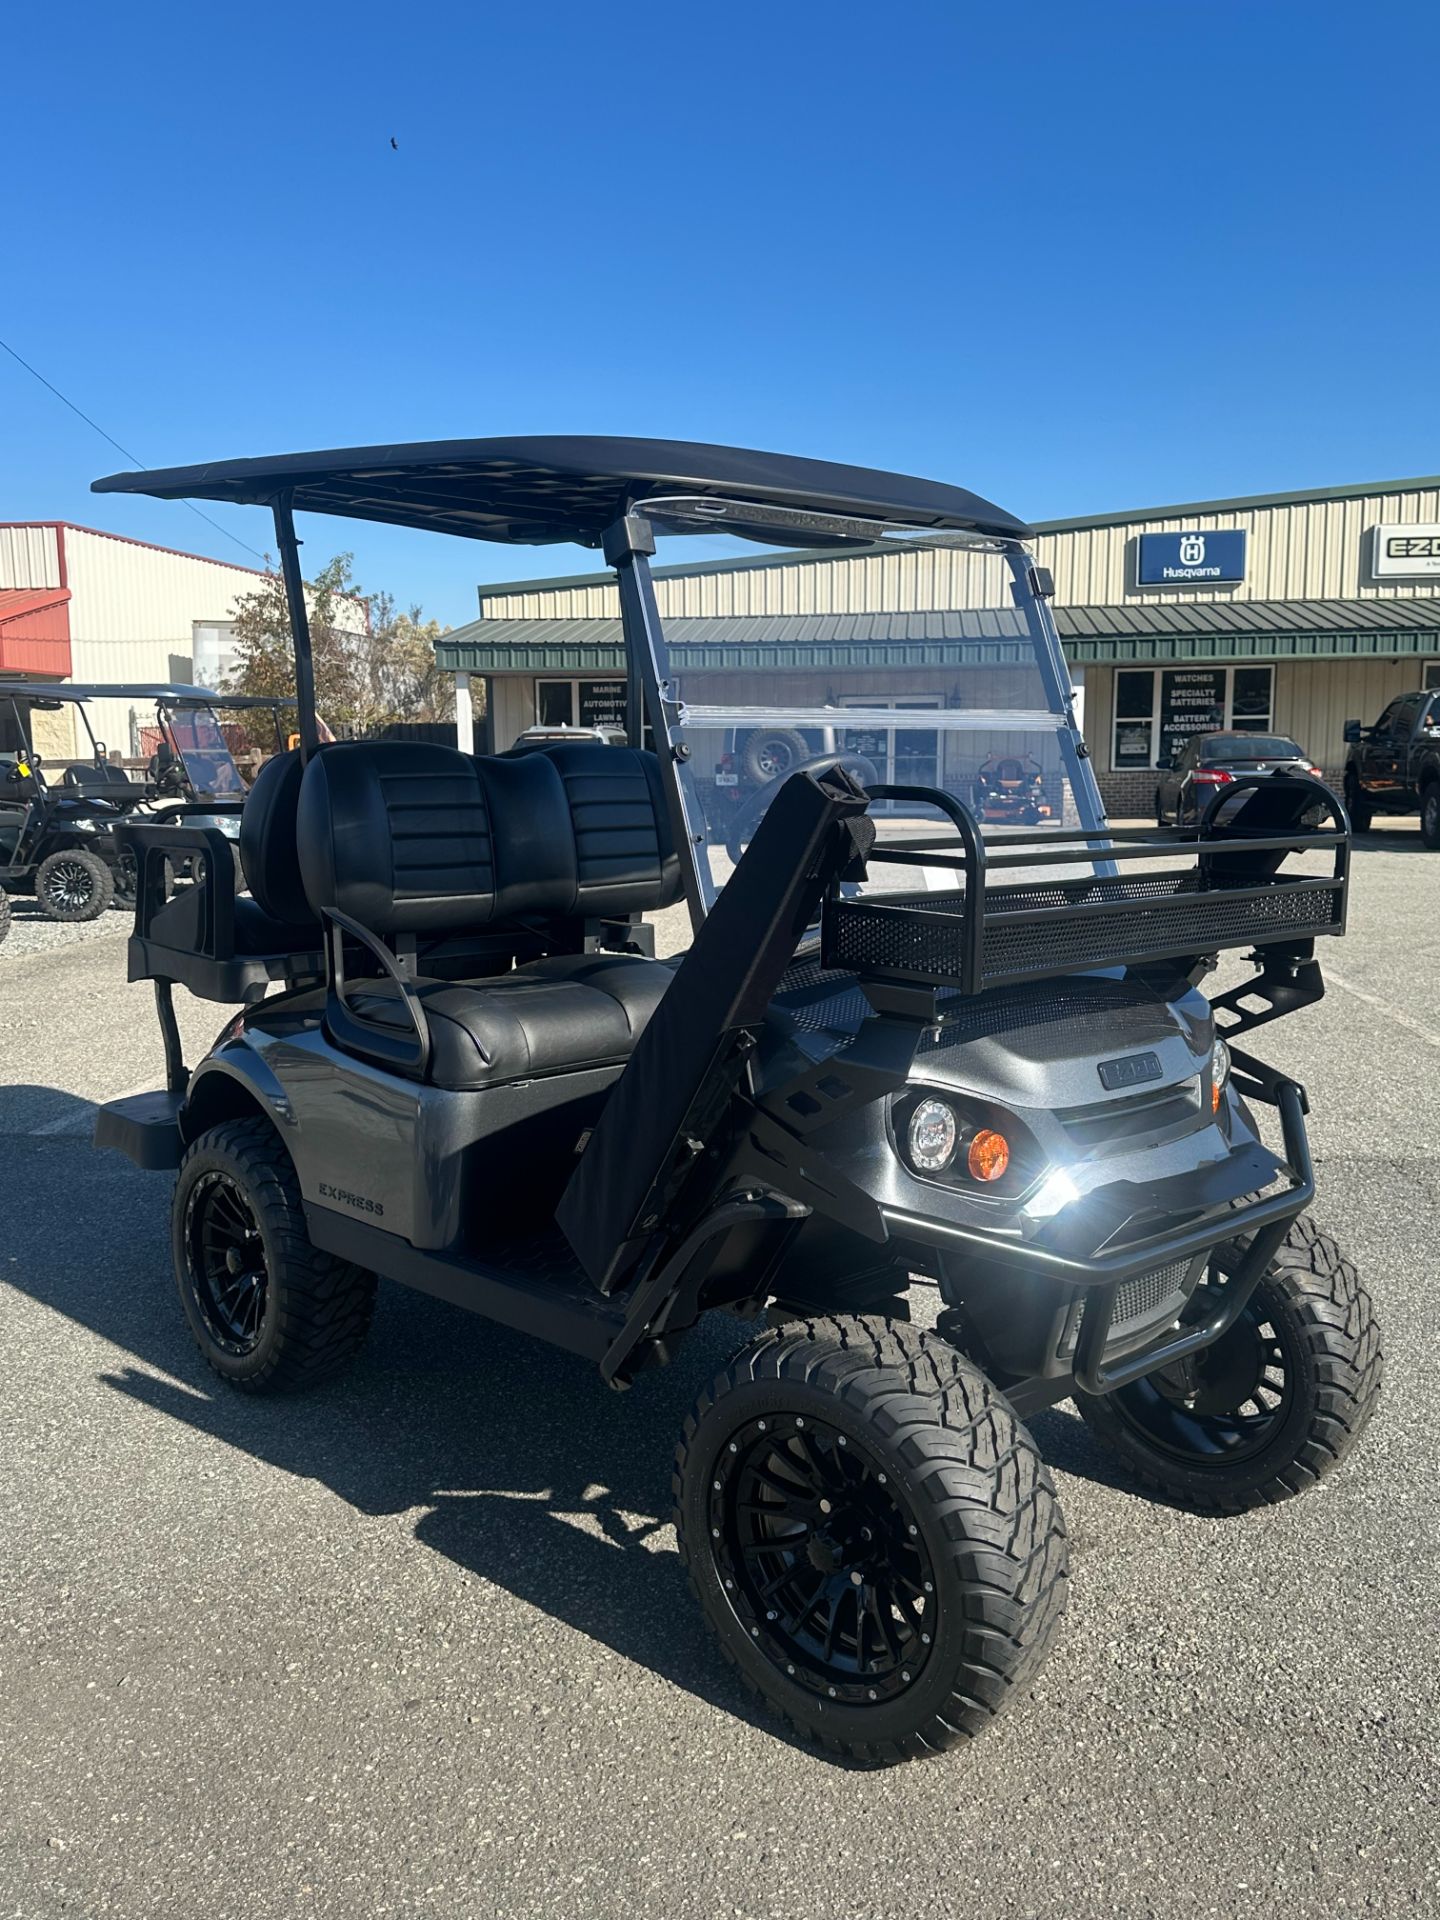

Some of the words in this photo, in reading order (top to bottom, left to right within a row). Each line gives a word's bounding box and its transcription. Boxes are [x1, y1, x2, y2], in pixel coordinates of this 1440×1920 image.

[1163, 567, 1220, 578] Husqvarna
[1174, 674, 1214, 682] WATCHES
[1171, 689, 1216, 697] SPECIALTY
[583, 700, 628, 708] AUTOMOTIV
[1170, 698, 1215, 706] BATTERIES
[1163, 723, 1221, 731] ACCESSORIES
[319, 1183, 384, 1216] EXPRESS
